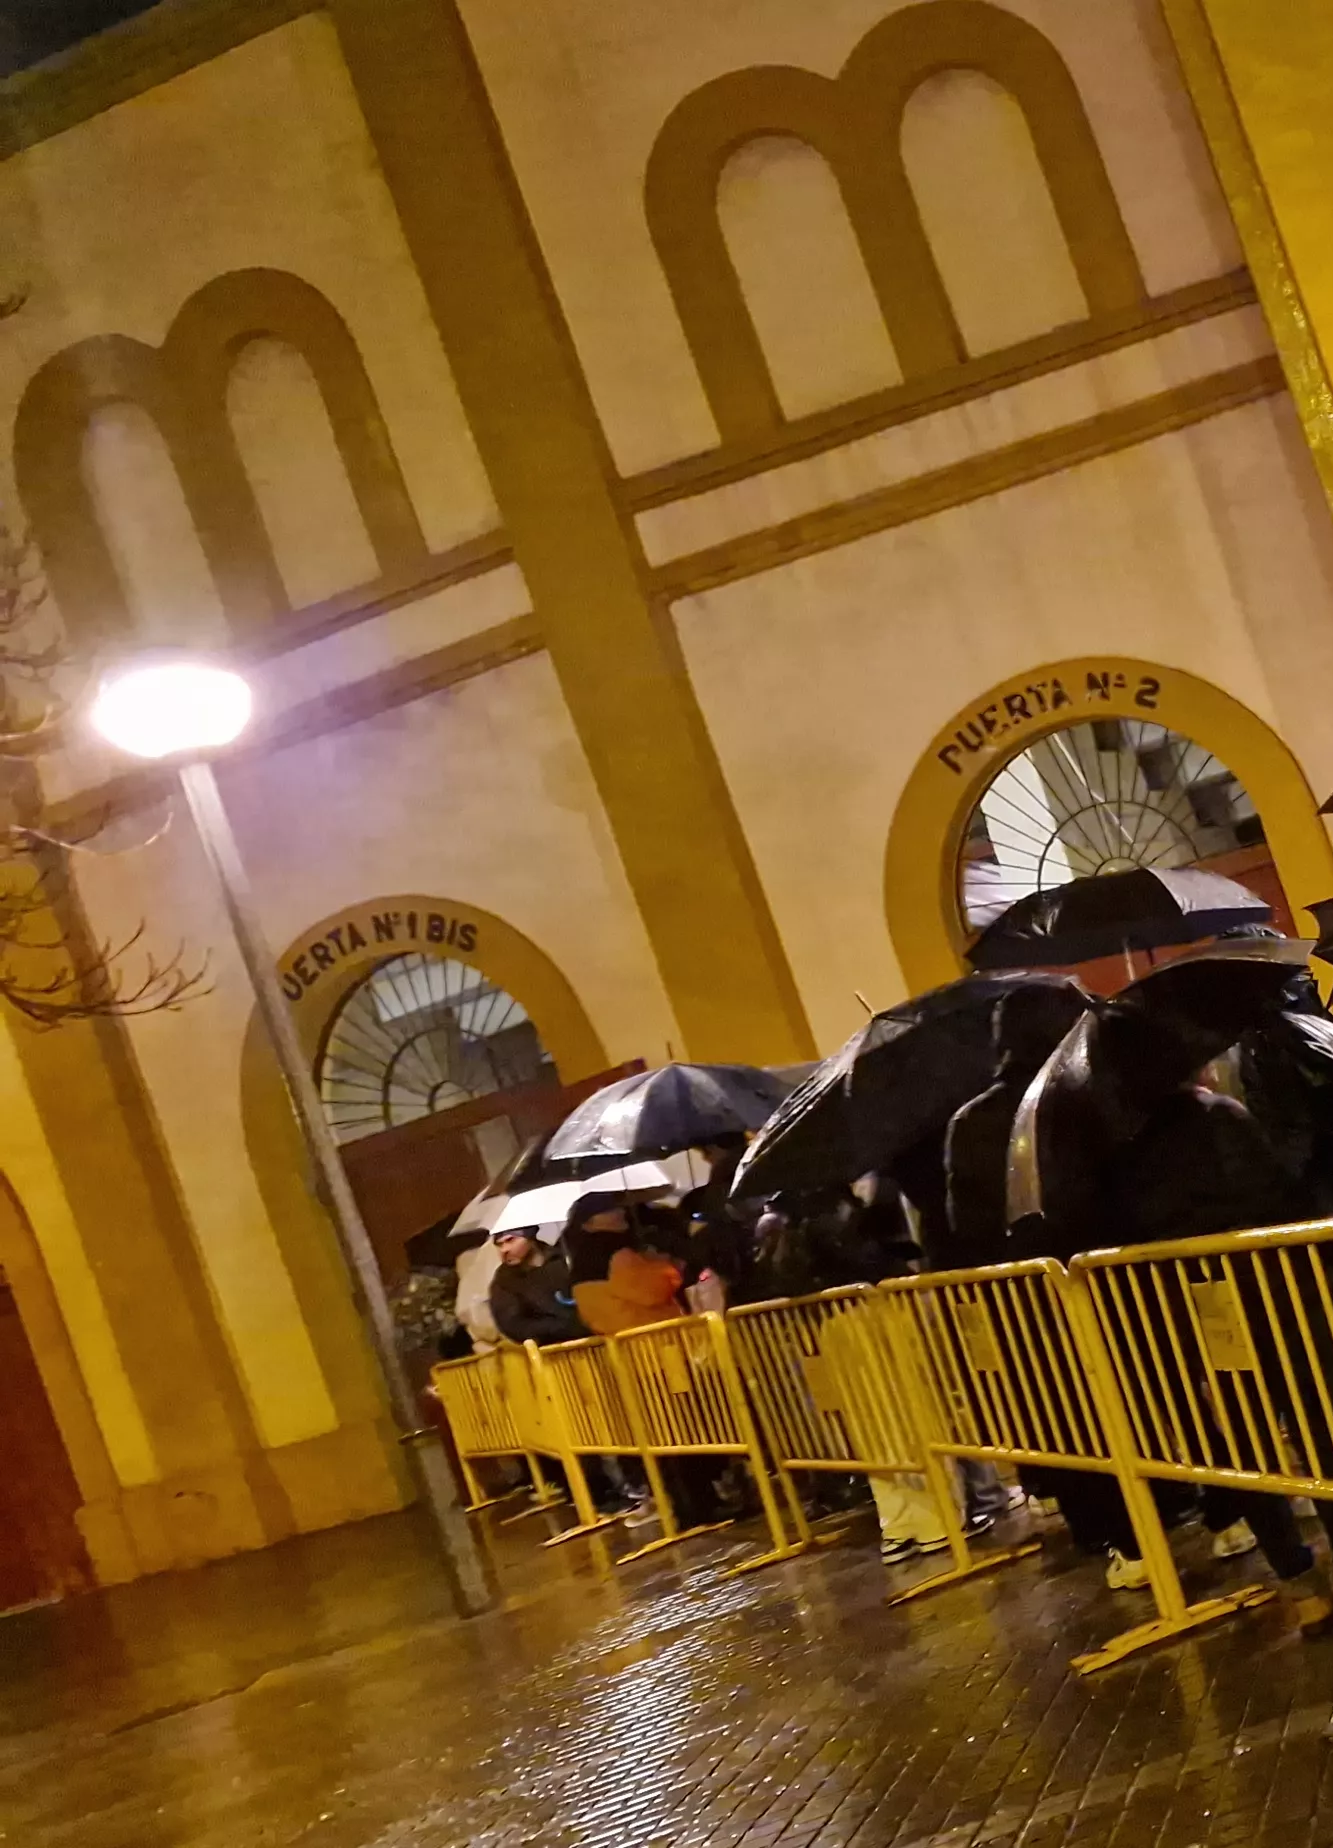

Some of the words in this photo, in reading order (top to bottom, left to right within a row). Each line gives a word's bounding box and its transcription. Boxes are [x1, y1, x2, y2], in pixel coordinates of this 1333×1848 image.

[937, 679, 1073, 776] PUERTA
[1134, 676, 1161, 710] 2
[283, 922, 368, 1002] UERTA
[427, 912, 478, 953] BIS
